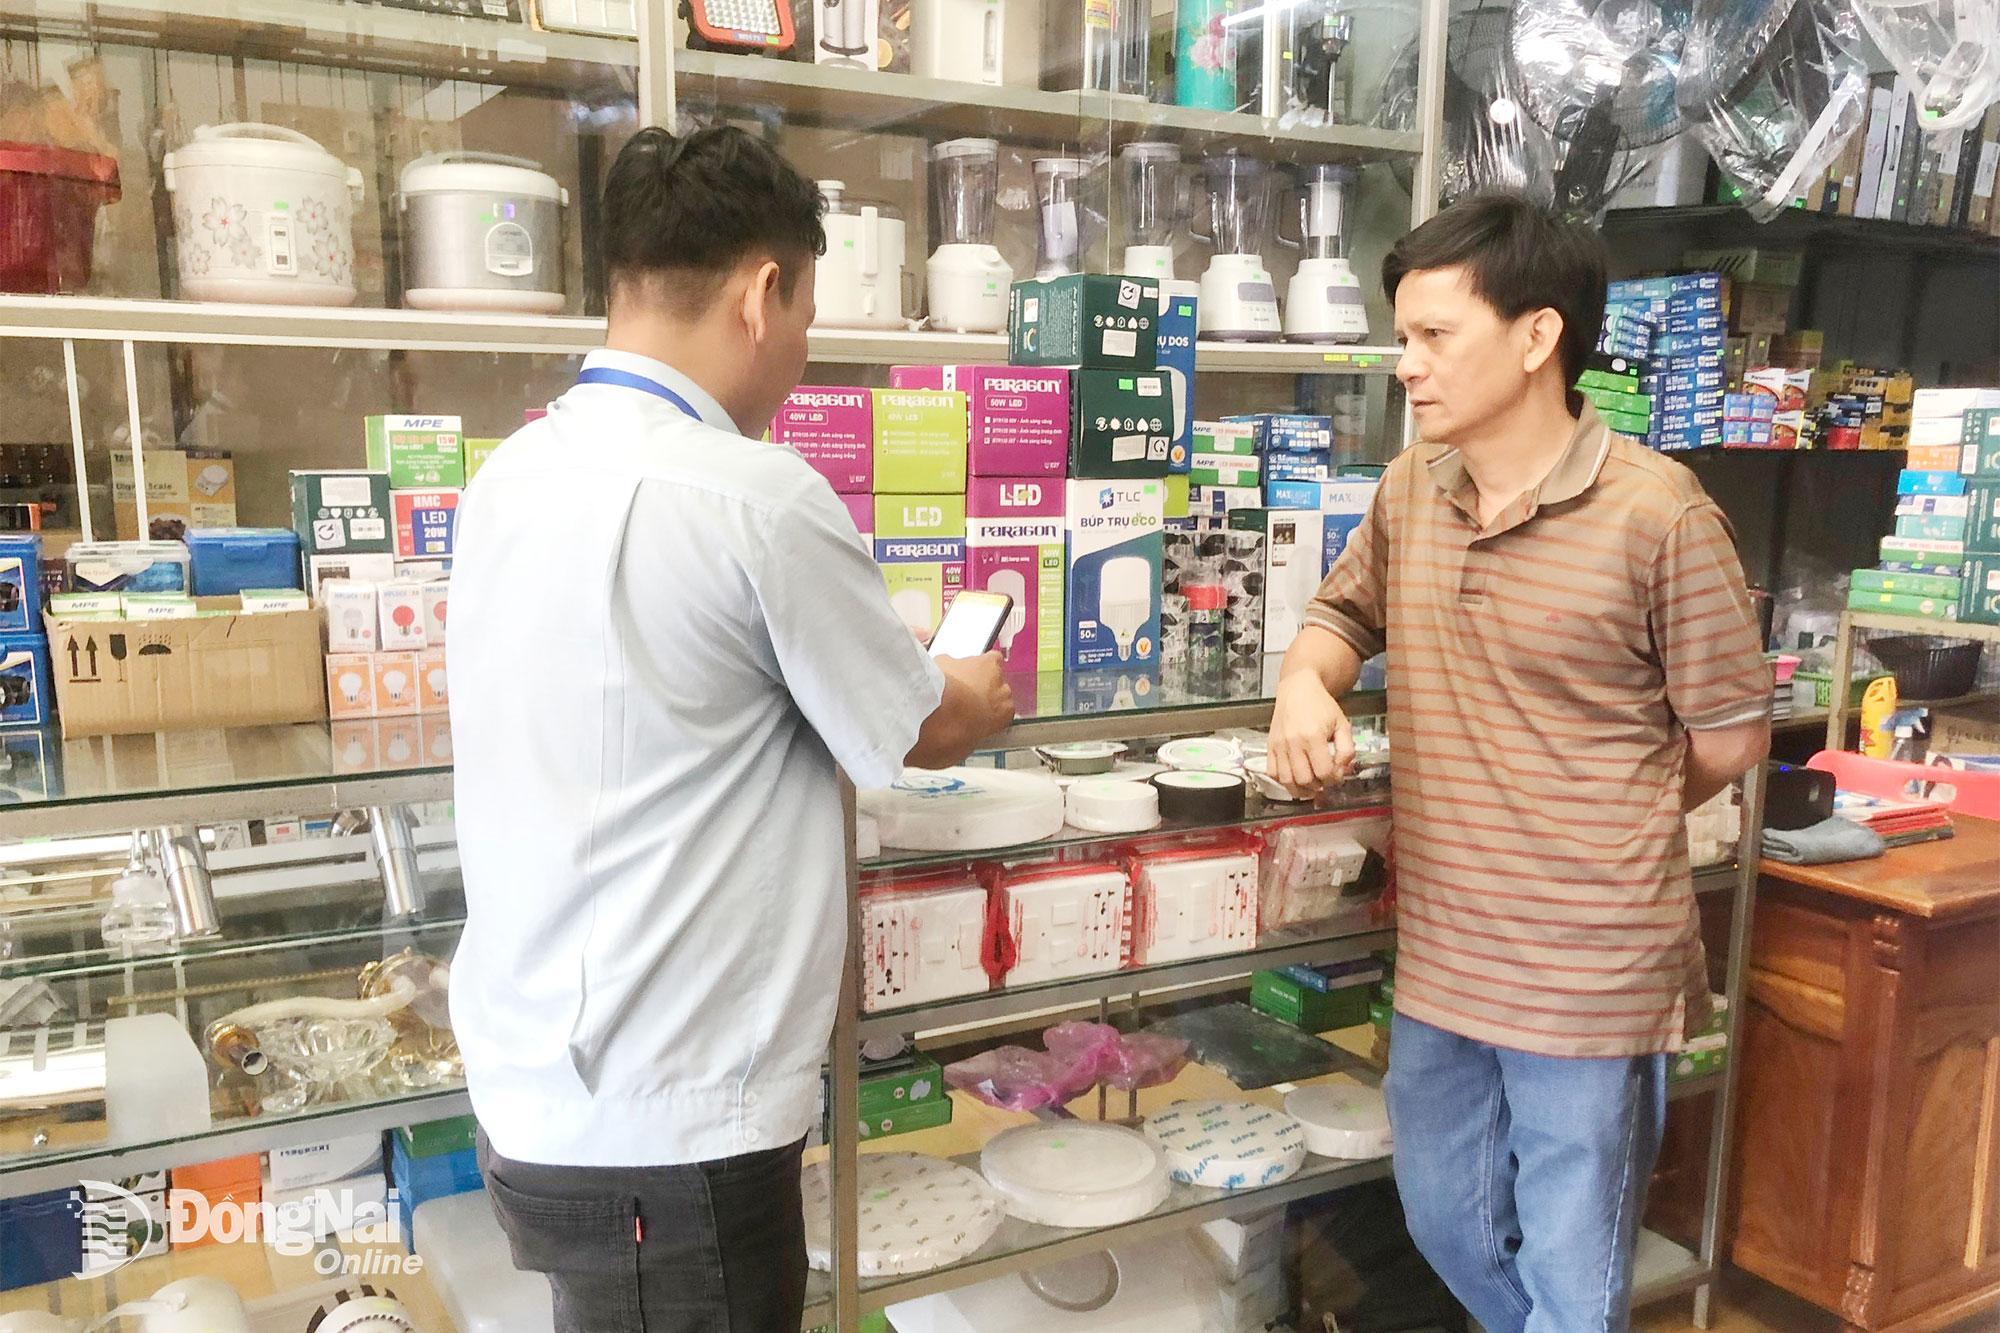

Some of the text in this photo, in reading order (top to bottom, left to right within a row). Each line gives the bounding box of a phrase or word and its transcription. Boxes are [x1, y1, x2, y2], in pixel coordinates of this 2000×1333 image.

[1168, 336, 1189, 346] DOS
[984, 378, 1061, 394] PARAGON
[1009, 399, 1022, 407] LED
[809, 413, 823, 421] LED
[404, 419, 444, 428] MPE
[1000, 484, 1041, 506] LED
[1116, 491, 1141, 502] TLC
[422, 511, 447, 524] LED
[903, 507, 942, 528] LED
[1081, 514, 1104, 527] BÚP
[1107, 516, 1130, 529] TRỤ
[424, 527, 447, 538] 20W
[981, 525, 1056, 538] PARAGON
[886, 543, 961, 557] PARAGON
[1044, 558, 1058, 566] LED
[71, 601, 100, 609] MPE
[263, 601, 289, 609] MPE
[148, 607, 176, 615] MPE
